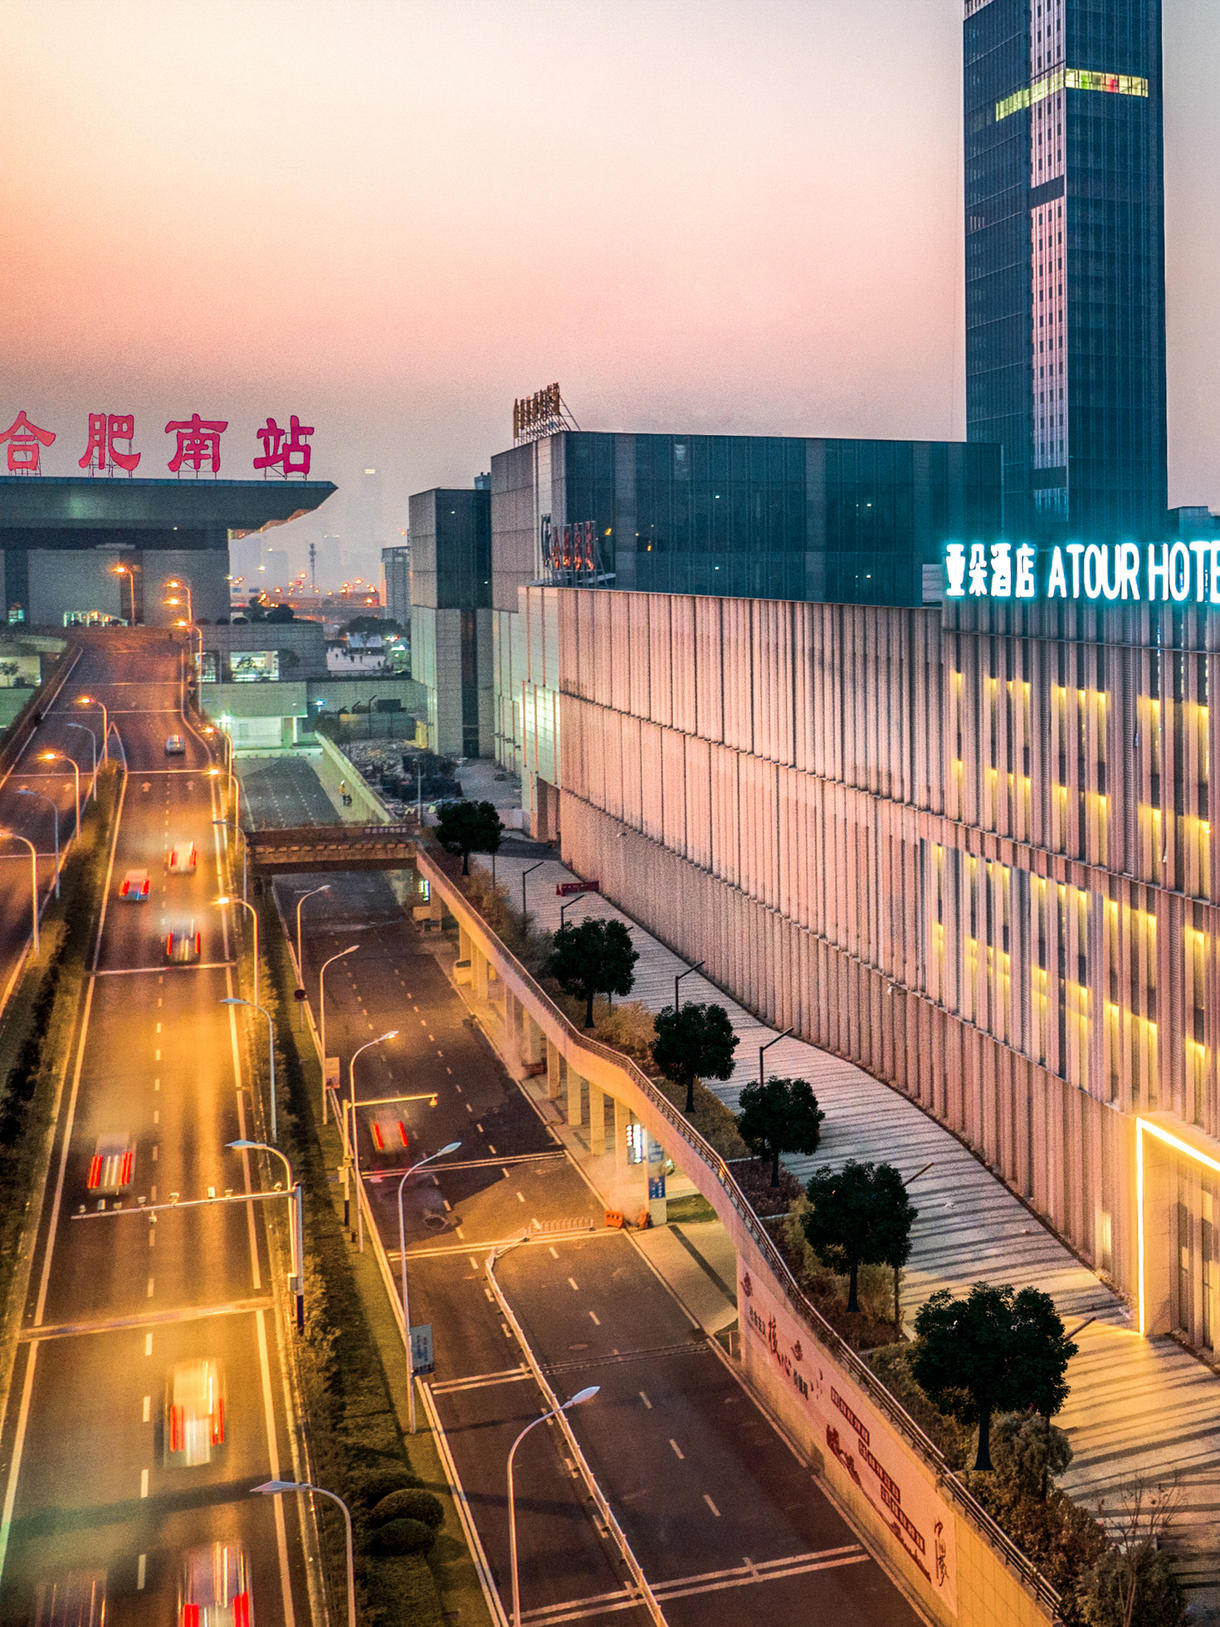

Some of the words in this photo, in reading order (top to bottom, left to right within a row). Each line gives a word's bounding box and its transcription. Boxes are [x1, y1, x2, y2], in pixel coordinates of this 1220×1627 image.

[0, 410, 315, 475] 合肥南站
[1048, 542, 1140, 600] ATOUR
